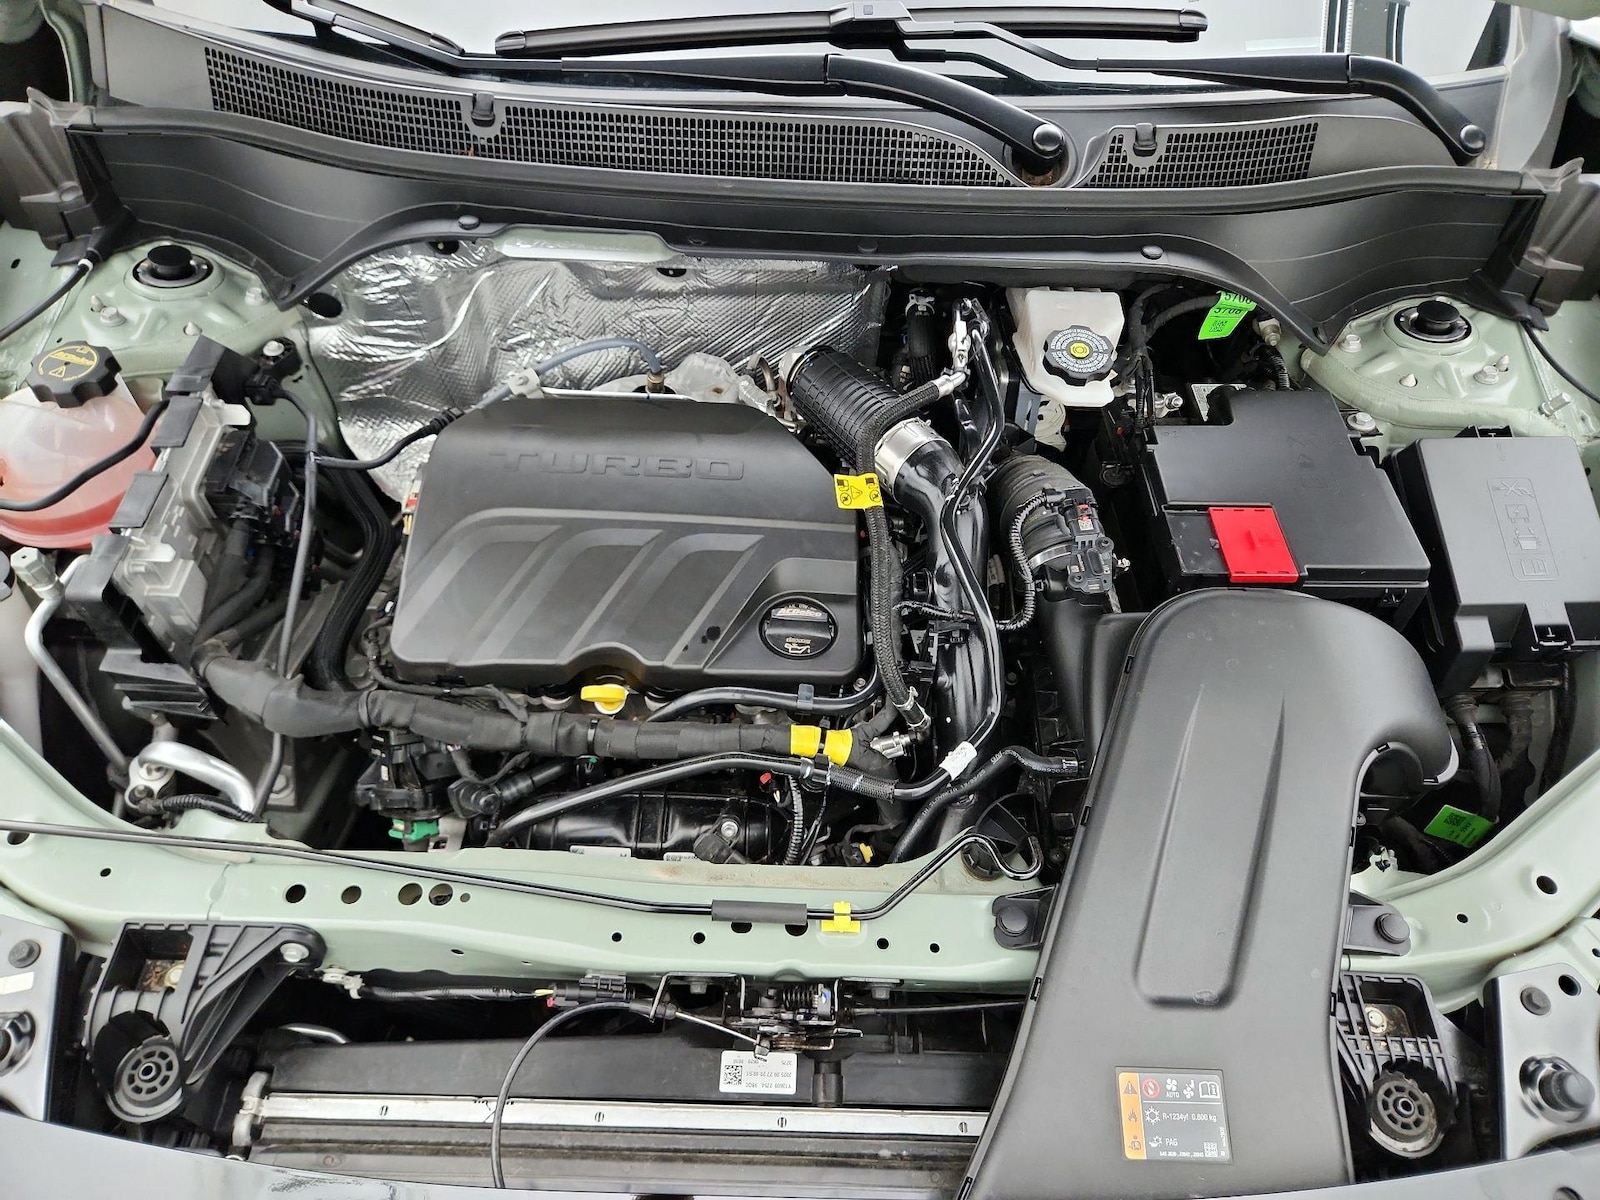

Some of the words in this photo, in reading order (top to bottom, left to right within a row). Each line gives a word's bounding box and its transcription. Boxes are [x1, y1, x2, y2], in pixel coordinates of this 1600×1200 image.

[488, 452, 745, 480] TURBO
[1162, 1112, 1189, 1122] R-1234yf
[1209, 1114, 1217, 1123] kg
[1165, 1138, 1178, 1146] PAG
